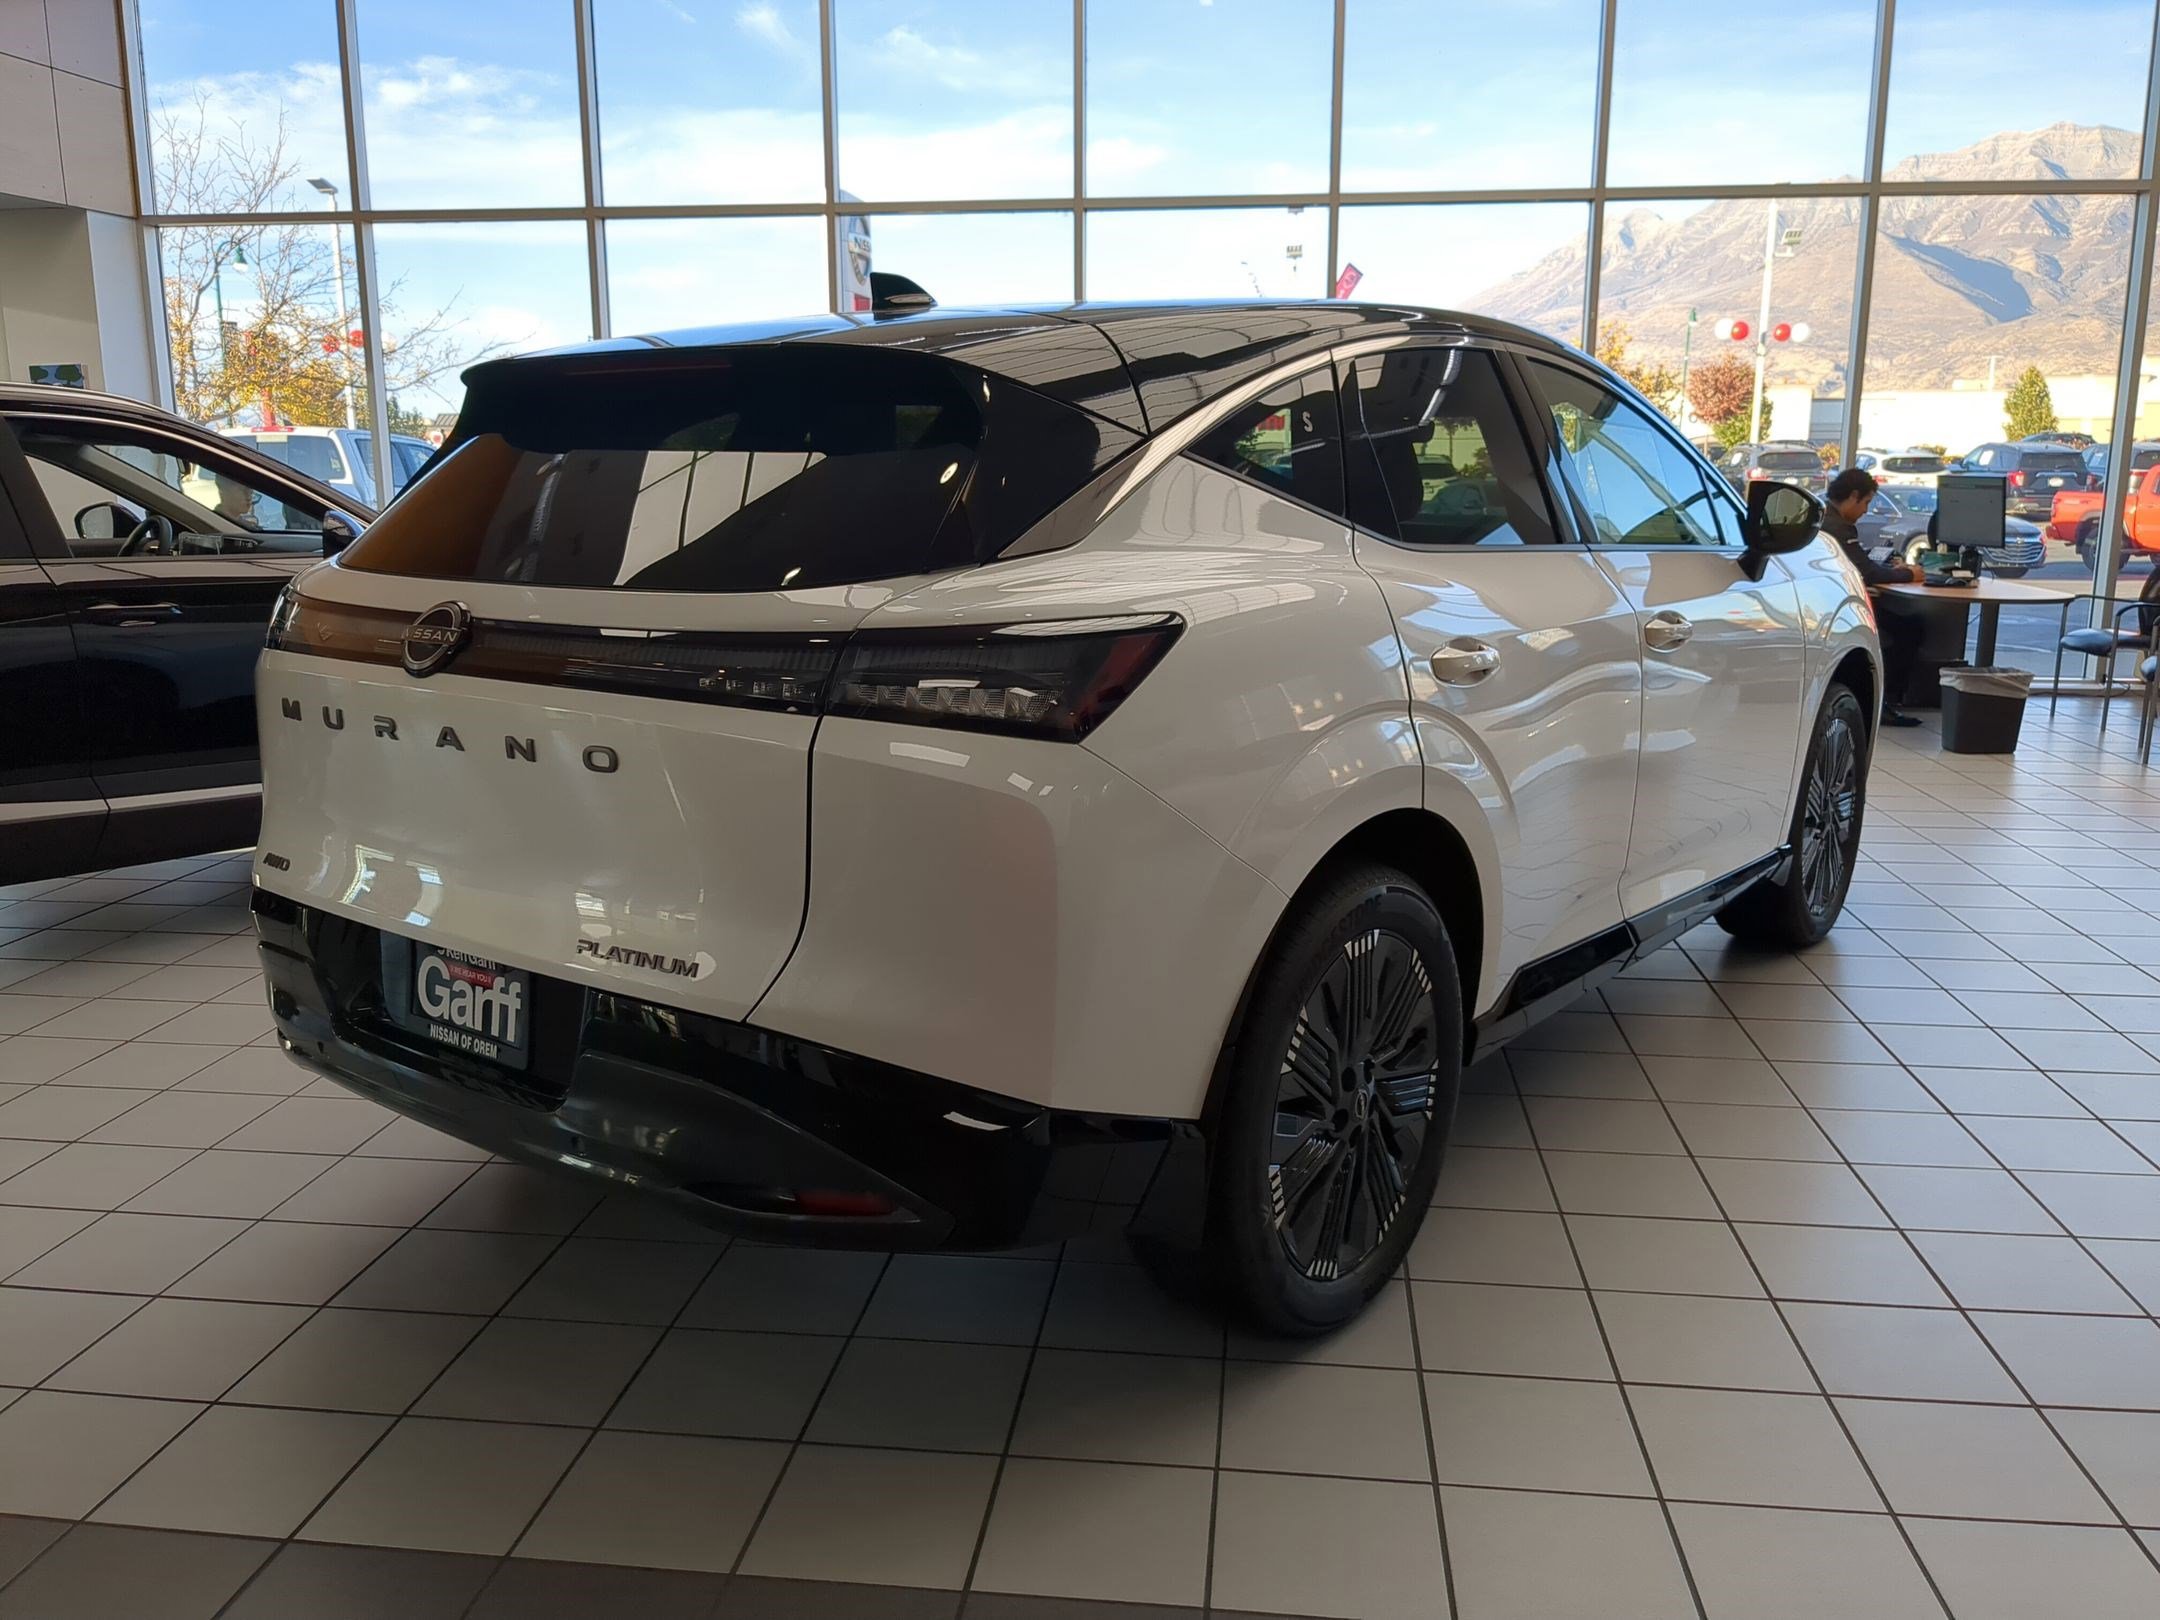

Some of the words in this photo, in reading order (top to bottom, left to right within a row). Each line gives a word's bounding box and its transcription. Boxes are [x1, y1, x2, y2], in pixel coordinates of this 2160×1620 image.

[281, 697, 619, 773] MURANO
[576, 938, 700, 978] PLATINUM
[417, 956, 521, 1042] Garff
[430, 1023, 459, 1046] NISSAN
[461, 1034, 473, 1049] OF
[473, 1038, 497, 1059] OREM
